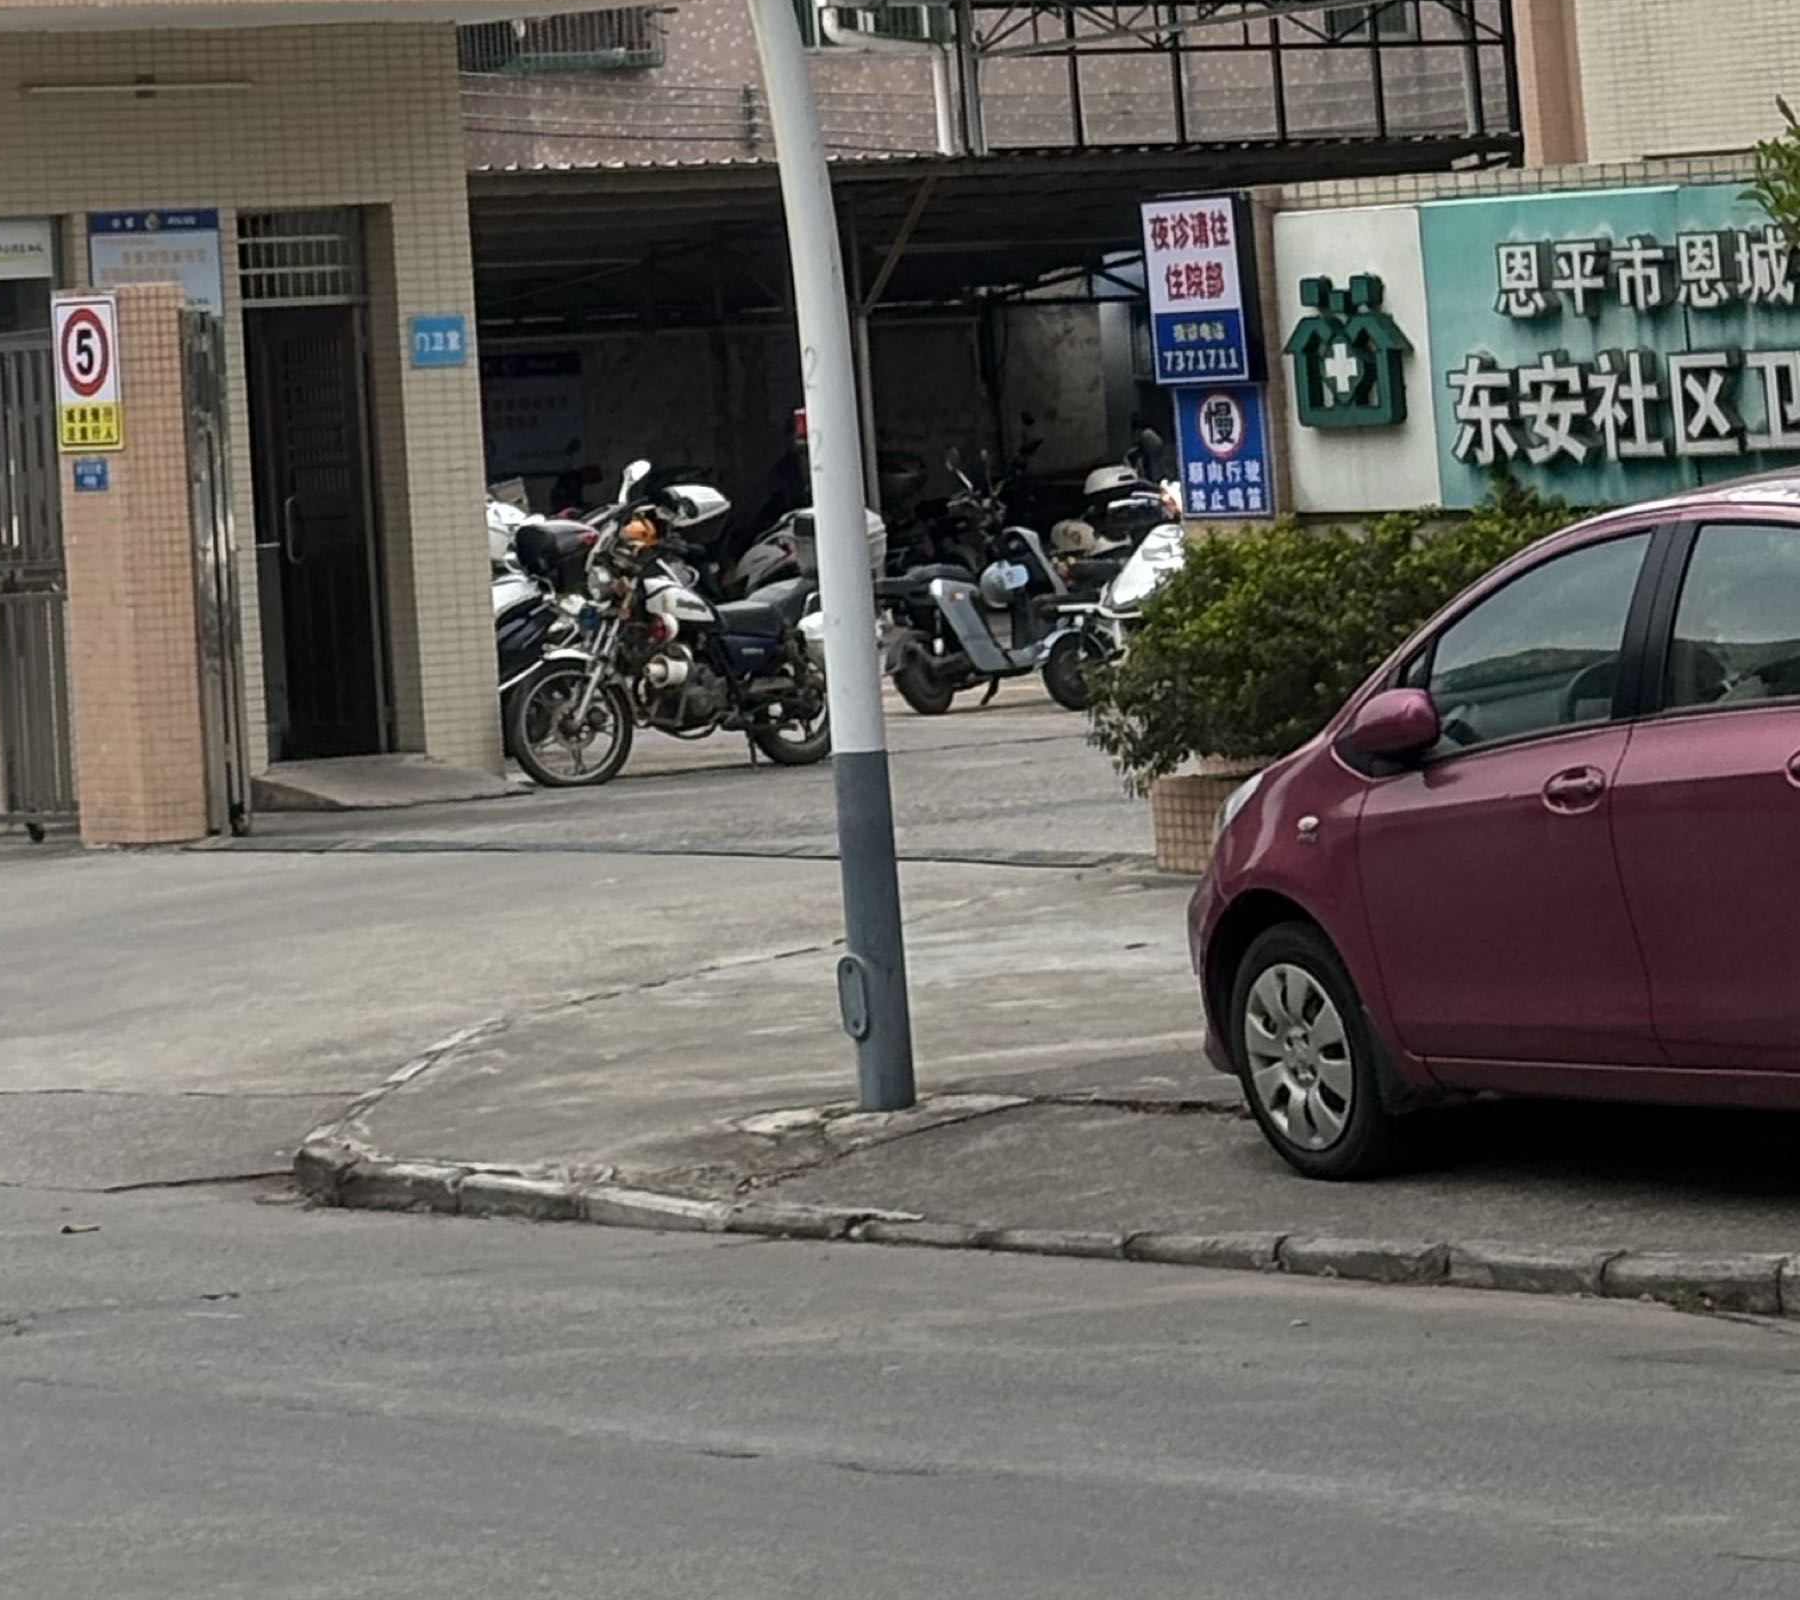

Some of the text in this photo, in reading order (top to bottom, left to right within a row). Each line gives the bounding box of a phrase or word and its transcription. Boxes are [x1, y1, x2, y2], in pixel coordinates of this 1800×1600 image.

[1149, 210, 1231, 251] 夜诊请往
[1165, 261, 1225, 301] 住院部
[1494, 226, 1795, 318] 恩平市恩城
[76, 329, 95, 376] 5
[1163, 348, 1239, 372] 7371711
[1204, 401, 1235, 445] 慢
[1446, 351, 1800, 465] 东安社区卫
